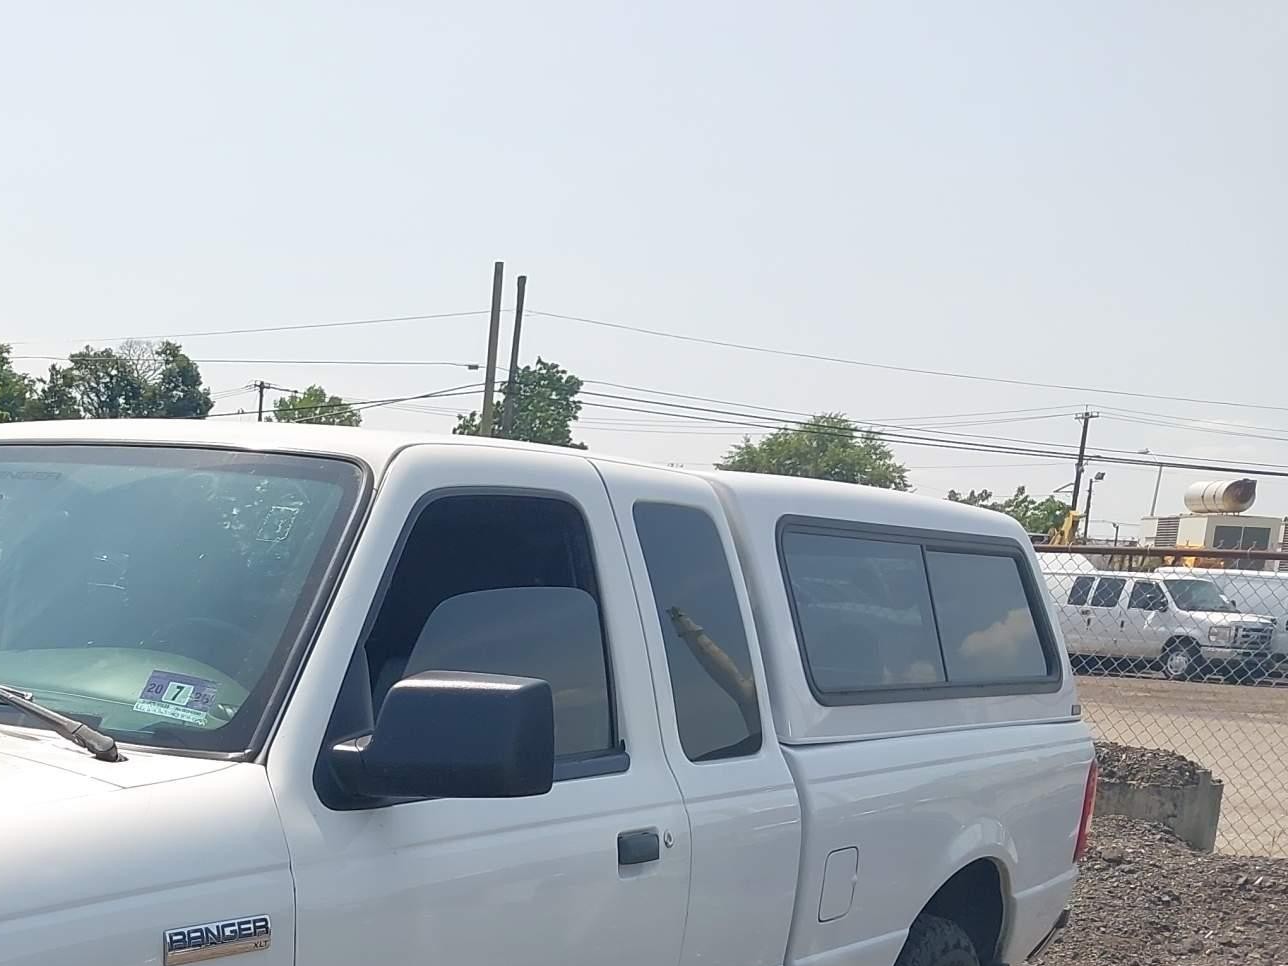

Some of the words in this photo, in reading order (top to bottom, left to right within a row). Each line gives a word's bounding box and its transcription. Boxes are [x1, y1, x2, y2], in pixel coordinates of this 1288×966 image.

[147, 682, 164, 695] 20
[171, 685, 185, 701] 7
[167, 917, 270, 953] RANGER
[253, 940, 268, 949] XLT
